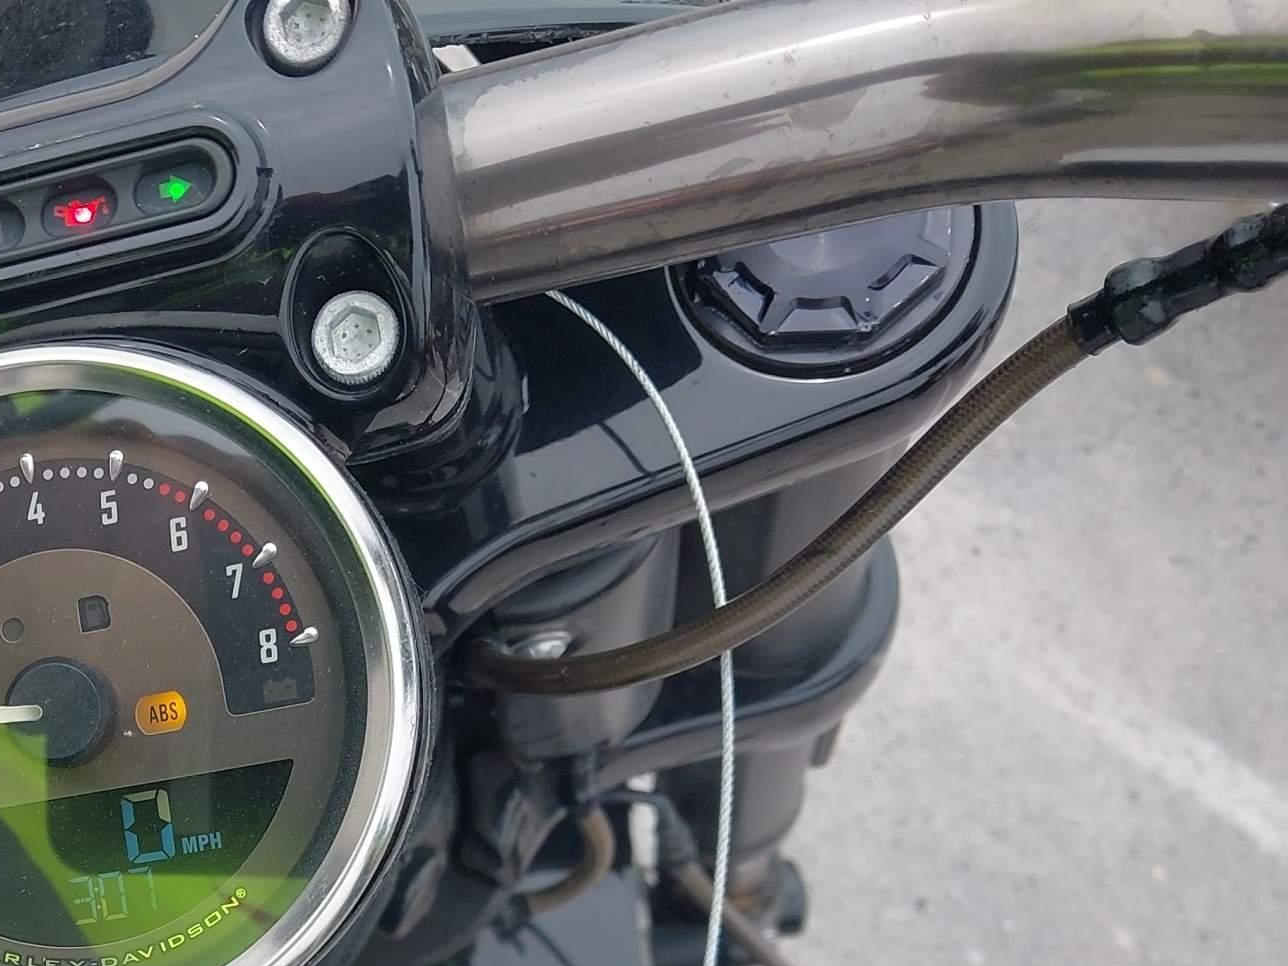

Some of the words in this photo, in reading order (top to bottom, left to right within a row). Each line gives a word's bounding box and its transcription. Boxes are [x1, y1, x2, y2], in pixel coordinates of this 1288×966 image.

[26, 492, 46, 525] 4
[100, 491, 119, 525] 5
[169, 519, 189, 553] 6
[225, 564, 244, 598] 7
[259, 629, 278, 663] 8
[148, 700, 180, 724] ABS
[120, 788, 177, 864] 0
[181, 831, 224, 855] MPH
